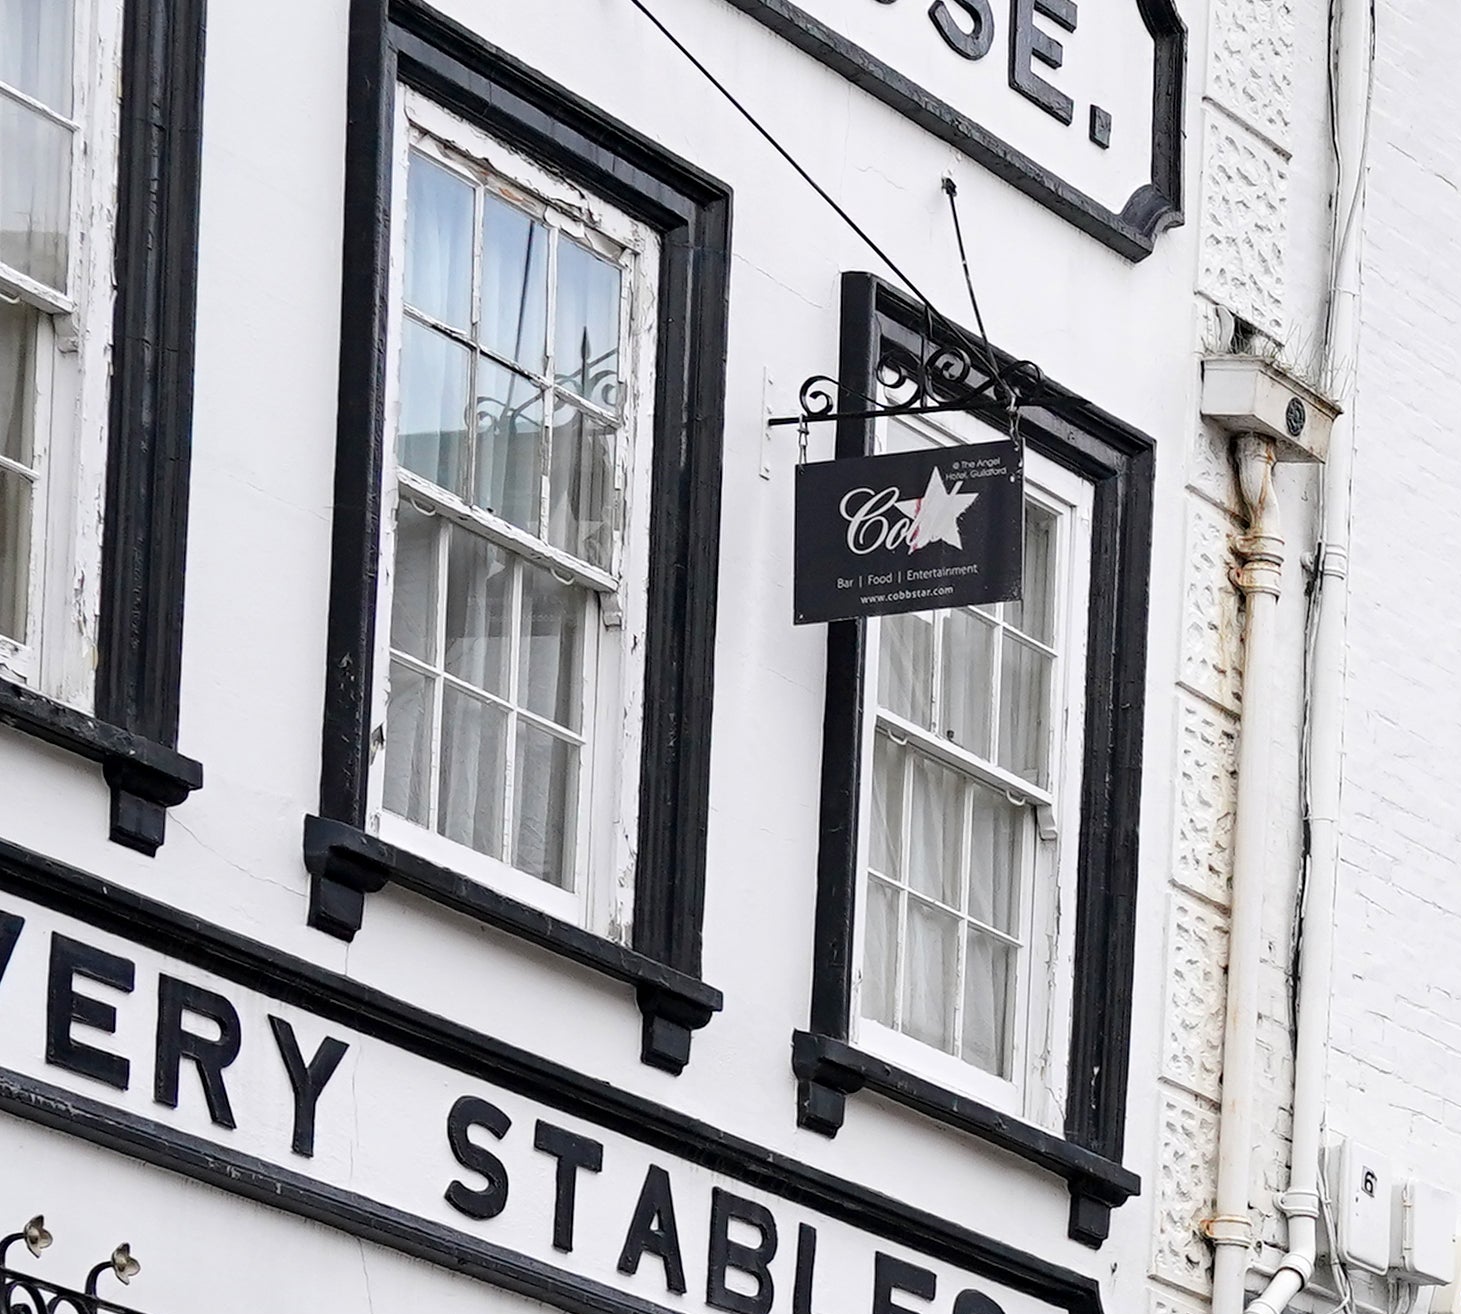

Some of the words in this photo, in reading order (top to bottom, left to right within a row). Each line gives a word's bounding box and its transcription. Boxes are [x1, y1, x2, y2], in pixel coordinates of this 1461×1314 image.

[977, 457, 1001, 469] Angel
[969, 467, 1007, 479] Guildford
[837, 578, 853, 589] Bar
[867, 572, 893, 585] Food
[907, 563, 979, 581] Entertainment
[860, 585, 954, 604] www.cobbstar.com
[0, 908, 350, 1158] ERY
